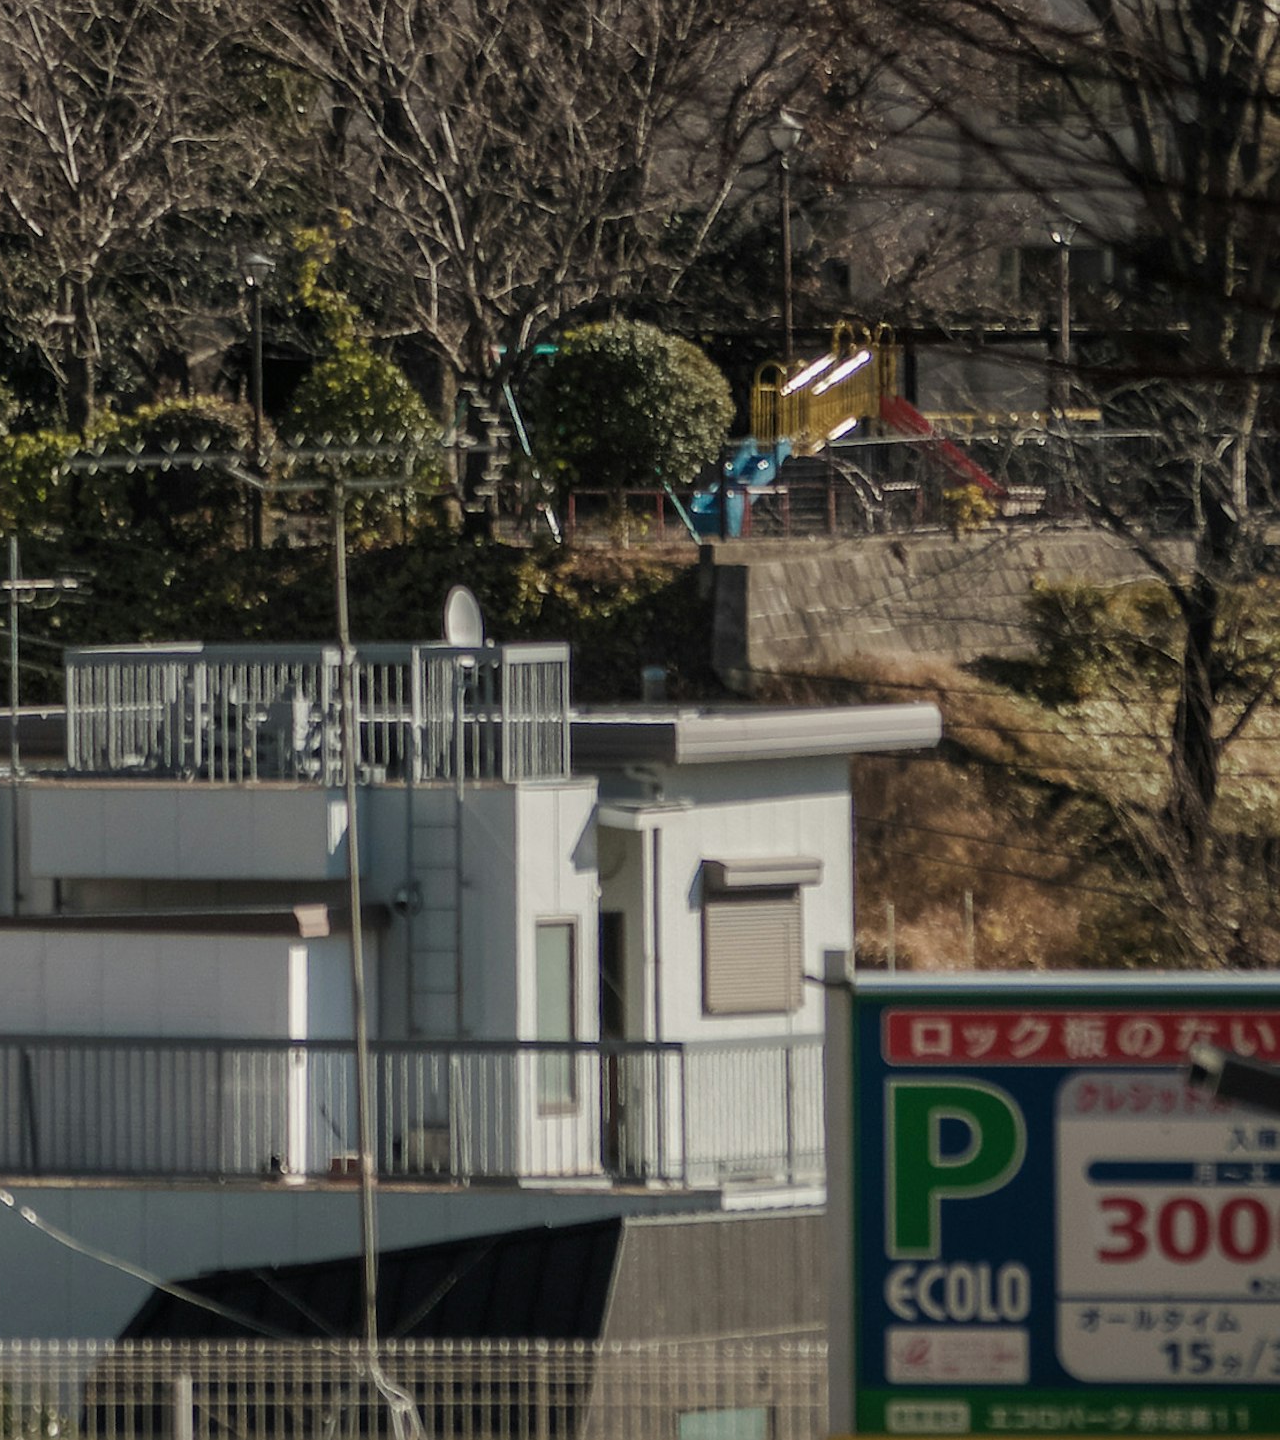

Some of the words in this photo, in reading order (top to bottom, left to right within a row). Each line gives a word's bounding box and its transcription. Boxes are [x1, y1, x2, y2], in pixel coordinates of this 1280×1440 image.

[1074, 1080, 1234, 1115] クレジット
[886, 1078, 1028, 1260] P
[1096, 1196, 1280, 1265] 300
[886, 1263, 1029, 1322] ECOLO
